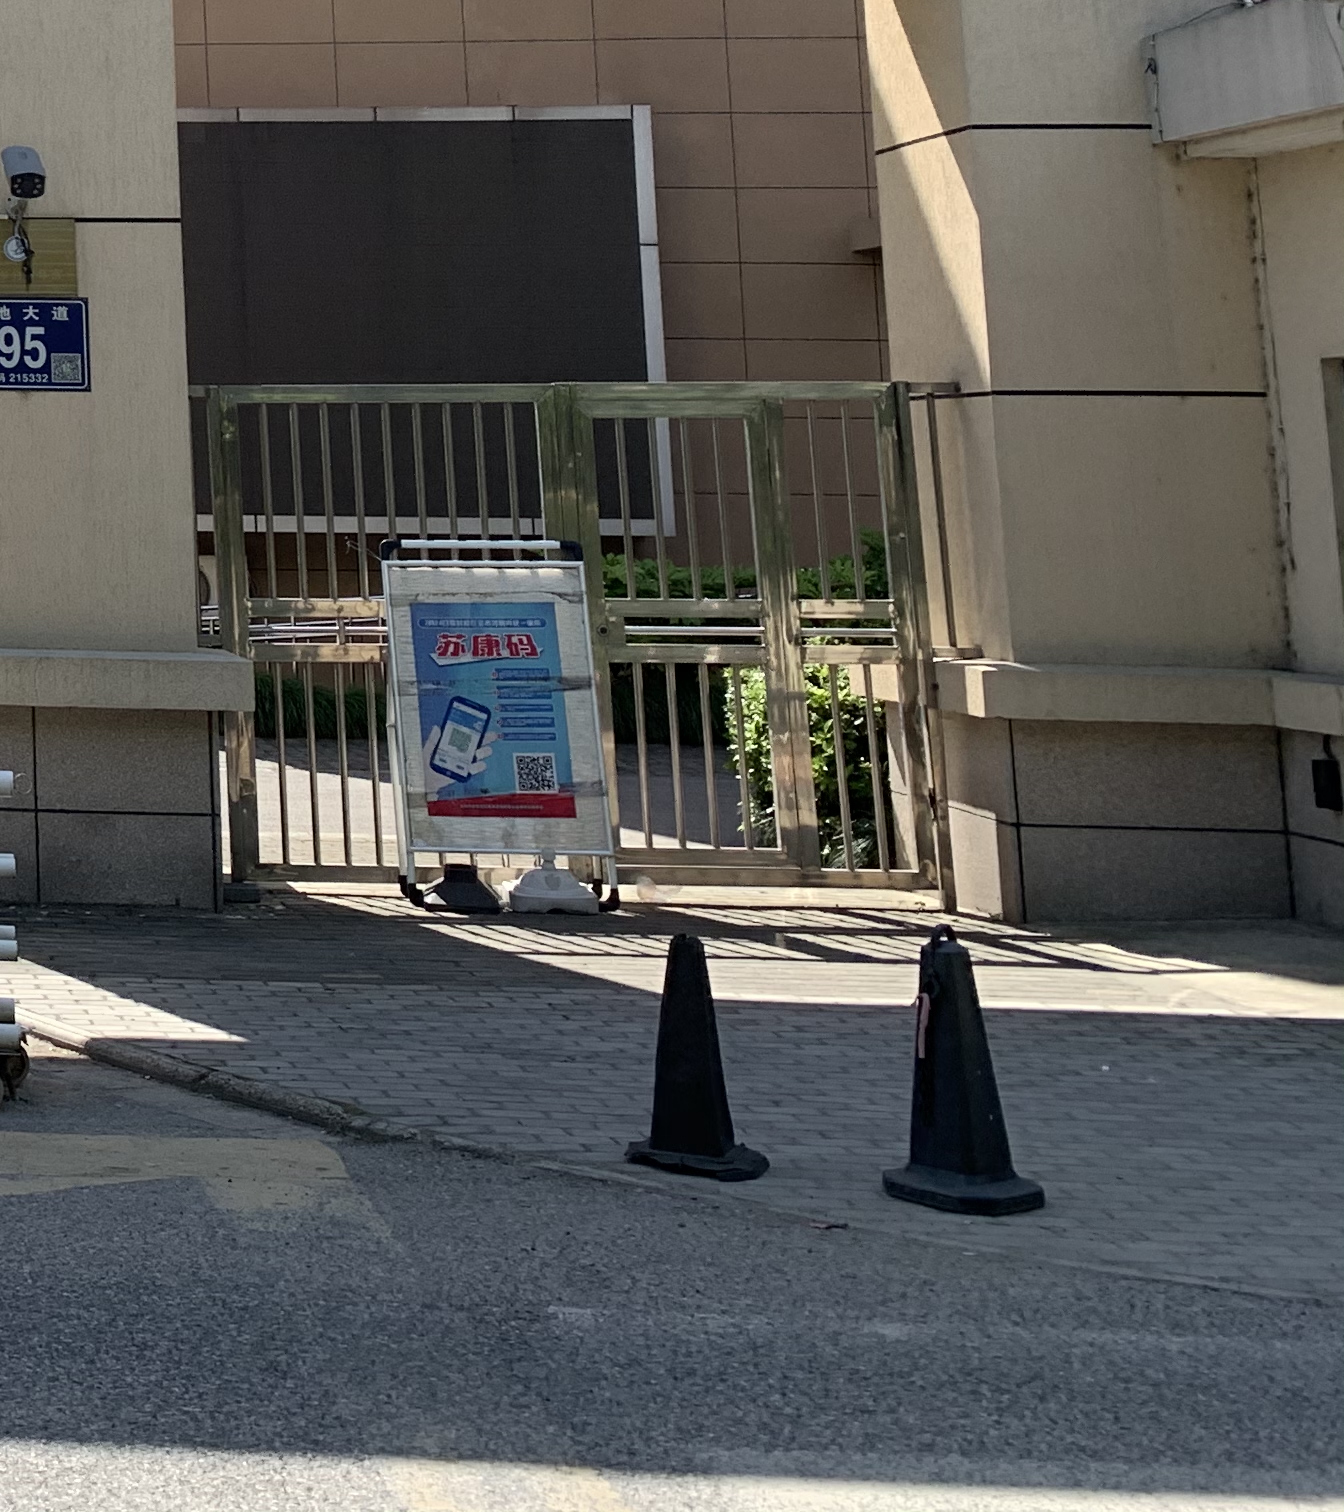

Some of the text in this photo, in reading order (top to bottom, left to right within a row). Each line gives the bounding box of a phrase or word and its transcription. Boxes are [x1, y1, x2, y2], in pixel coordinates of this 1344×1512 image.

[9, 373, 49, 383] 215332
[435, 632, 541, 659] 苏康码
